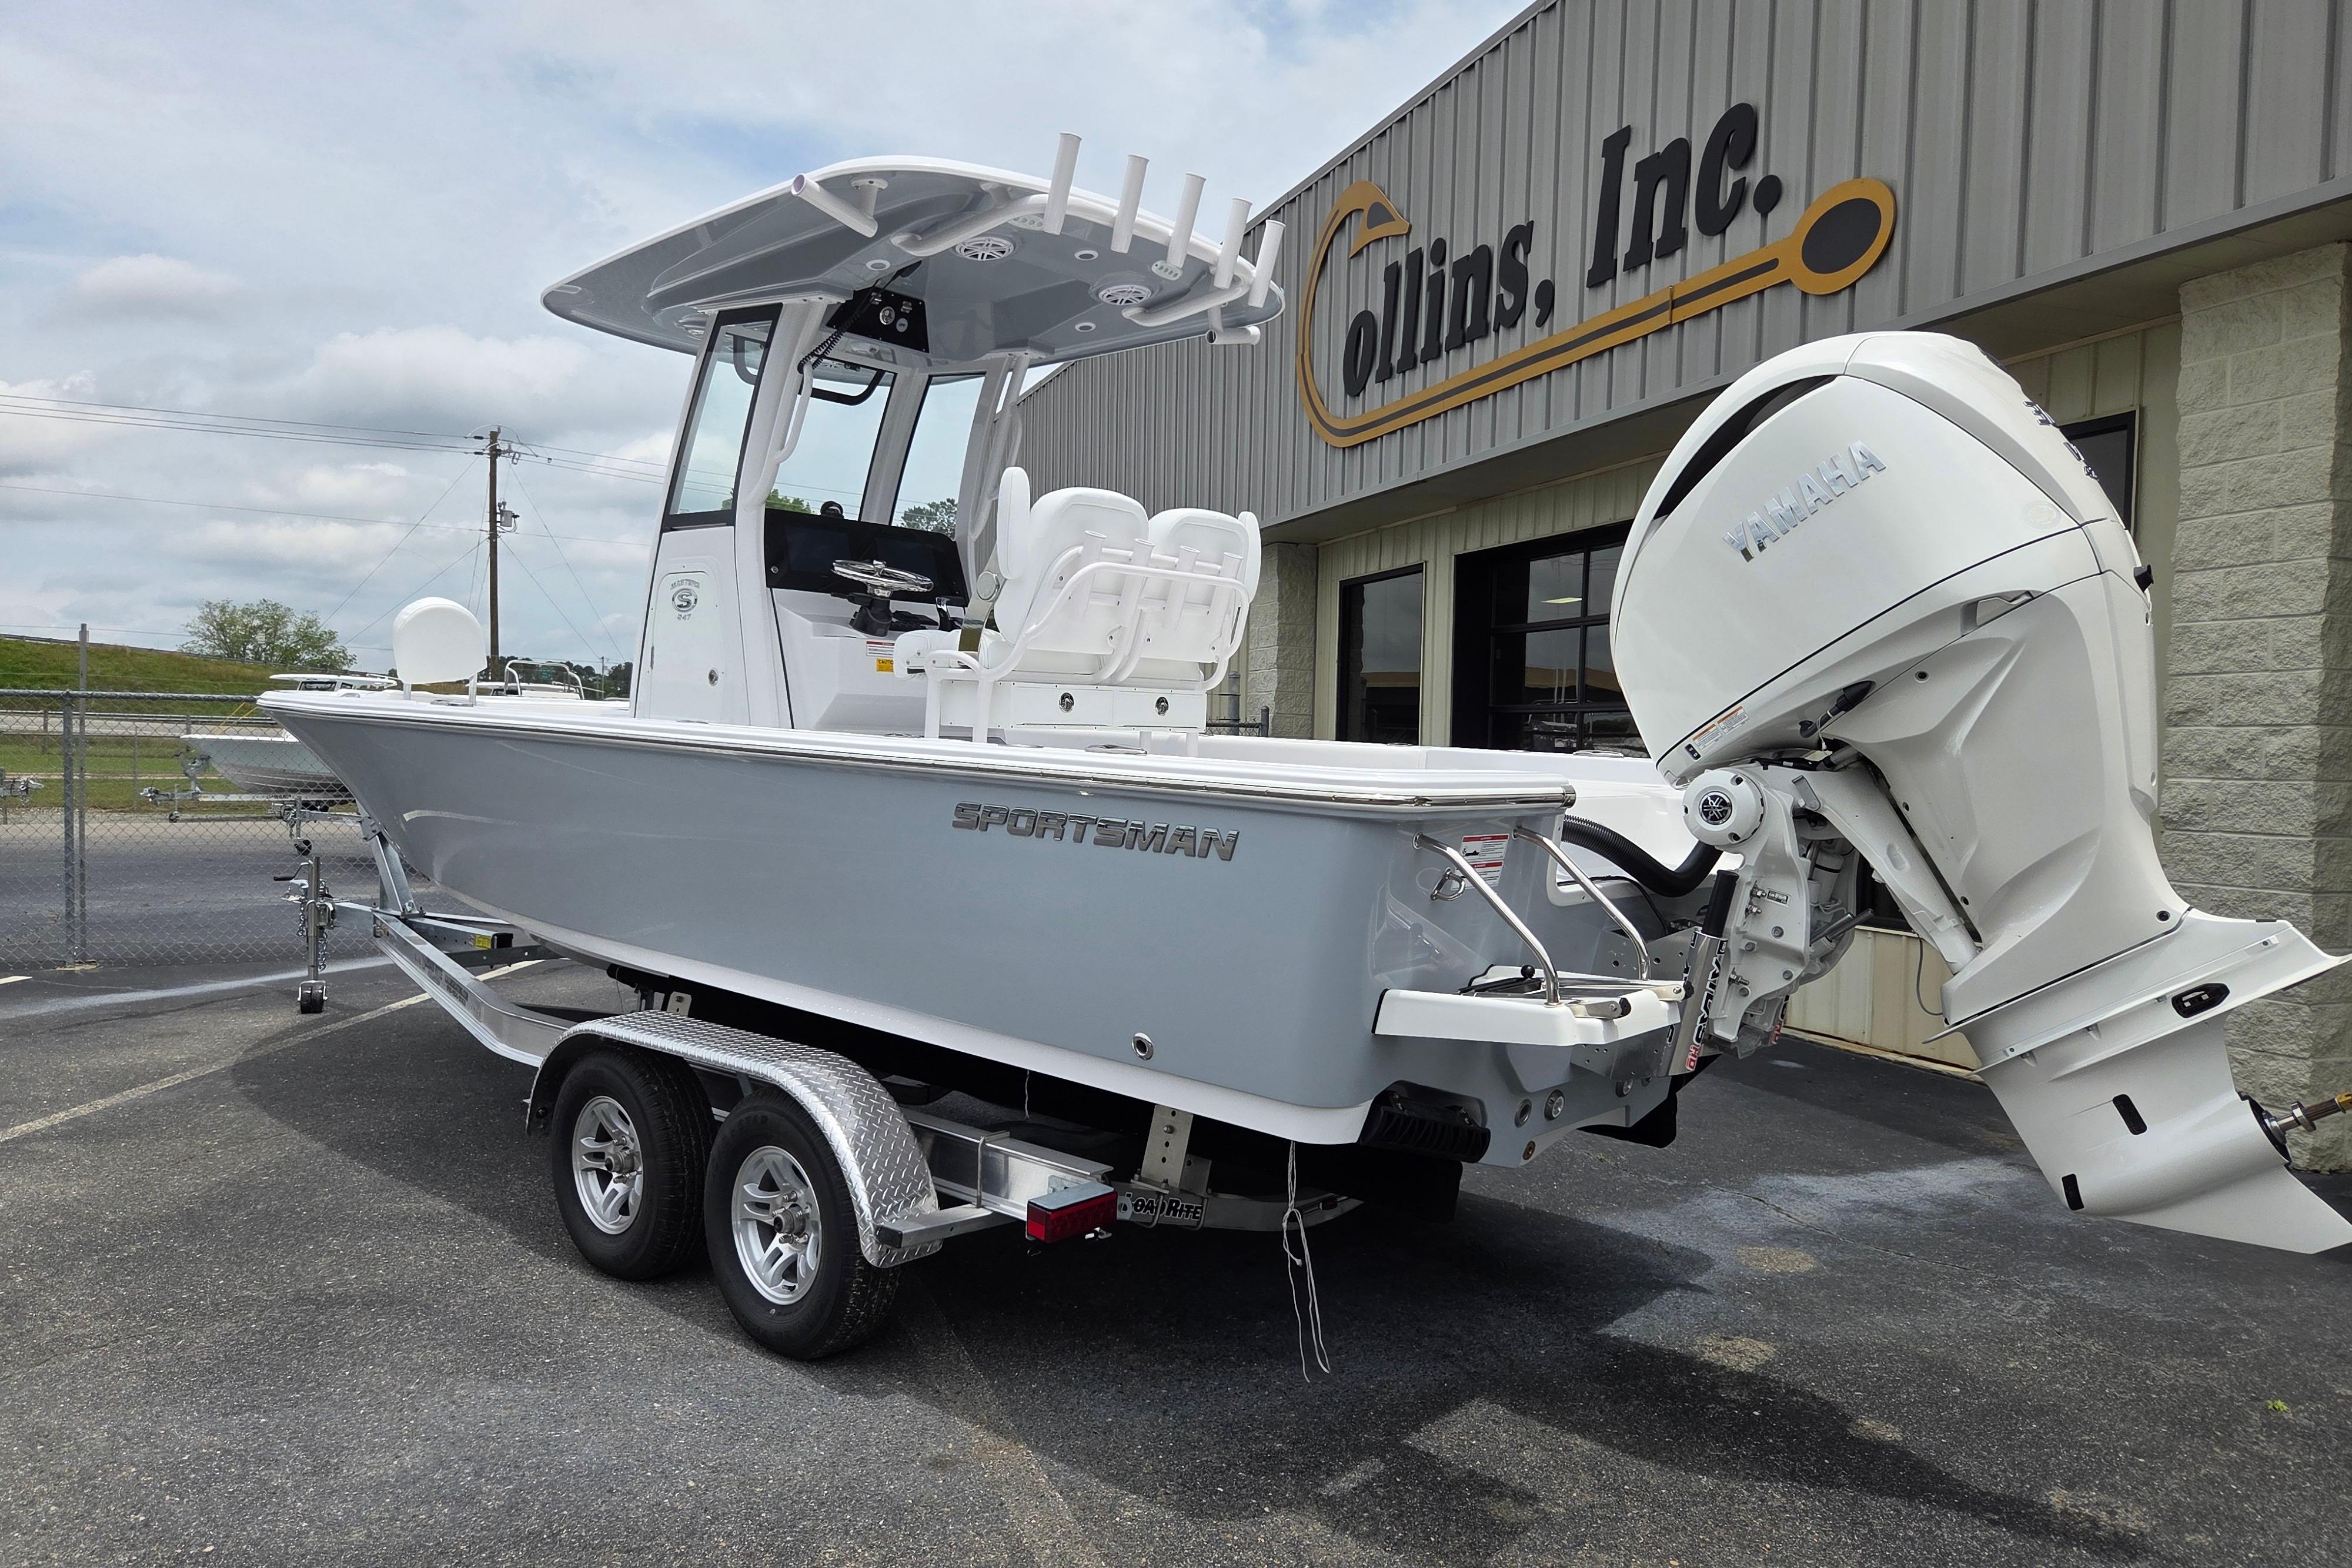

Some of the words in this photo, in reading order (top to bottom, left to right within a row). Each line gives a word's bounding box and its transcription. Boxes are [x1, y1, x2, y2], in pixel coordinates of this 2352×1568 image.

[1585, 102, 1782, 289] Inc.
[1722, 440, 1886, 562] YAMAHA
[951, 801, 1240, 862] SPORTSMAN
